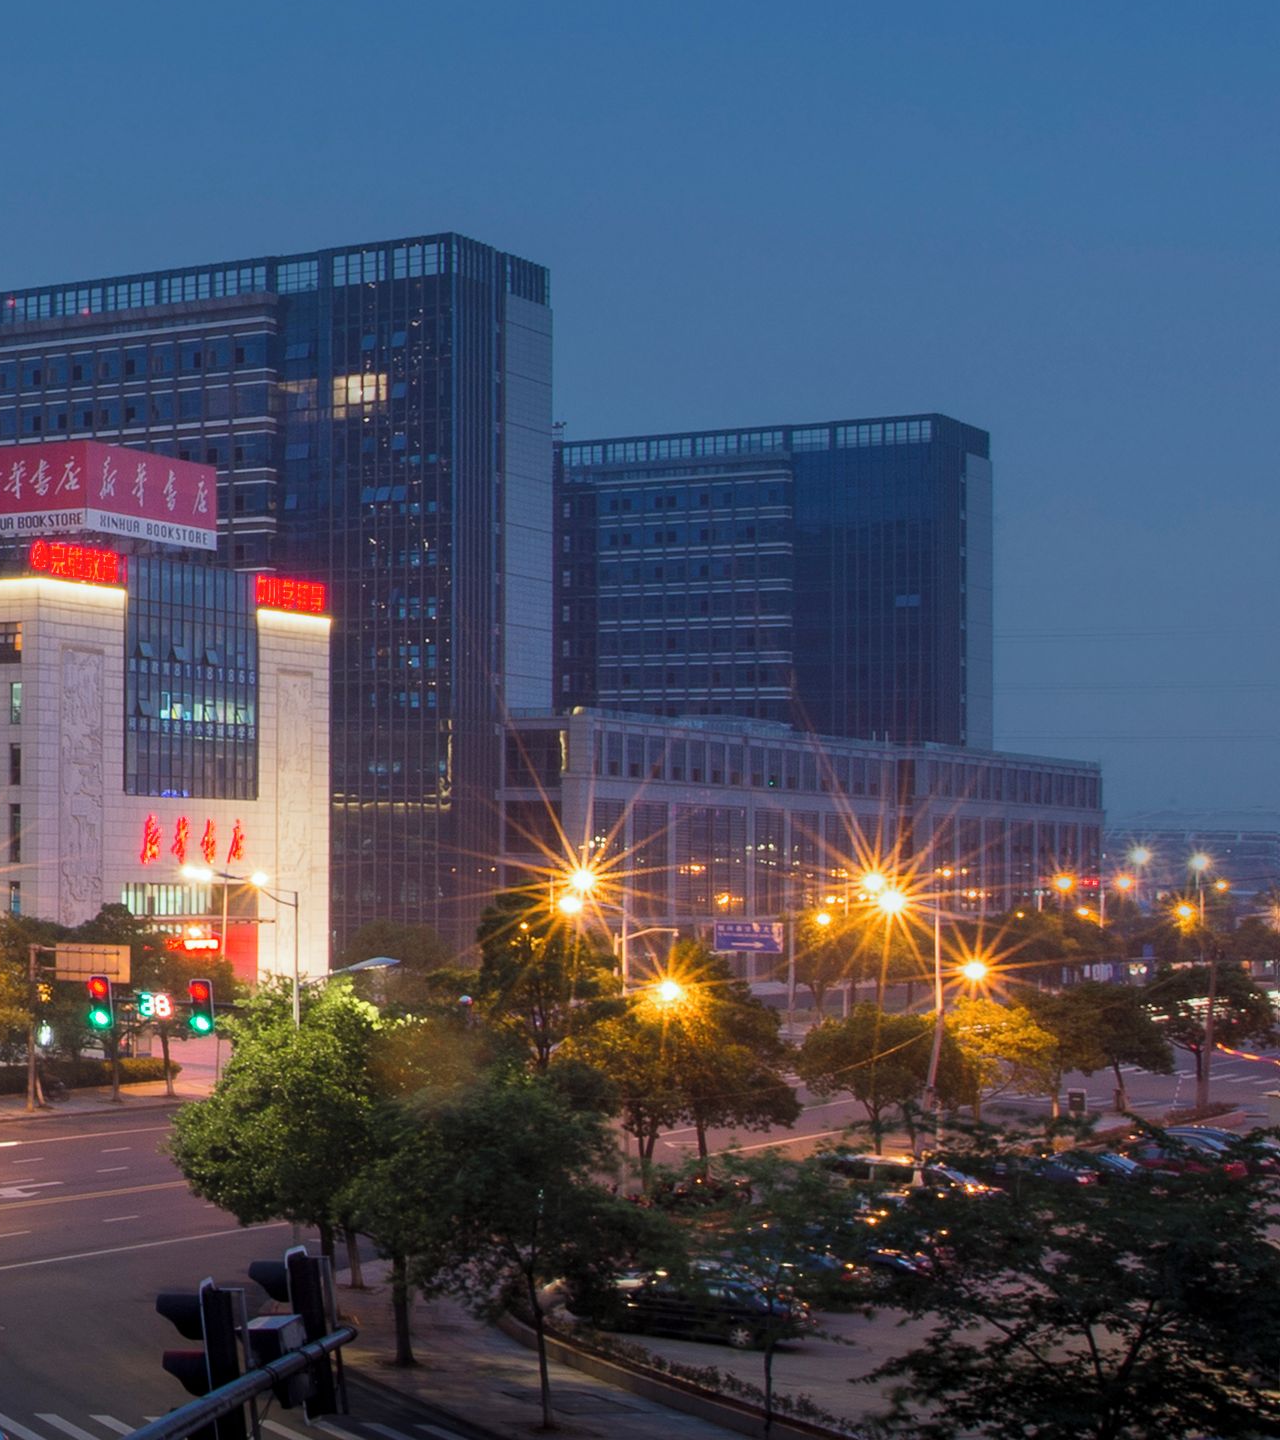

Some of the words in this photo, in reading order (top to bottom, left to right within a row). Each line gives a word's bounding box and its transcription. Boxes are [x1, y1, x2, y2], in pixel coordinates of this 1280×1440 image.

[17, 511, 83, 529] BOOKSTORE
[99, 514, 141, 533] XINHUA
[146, 522, 209, 546] BOOKSTORE
